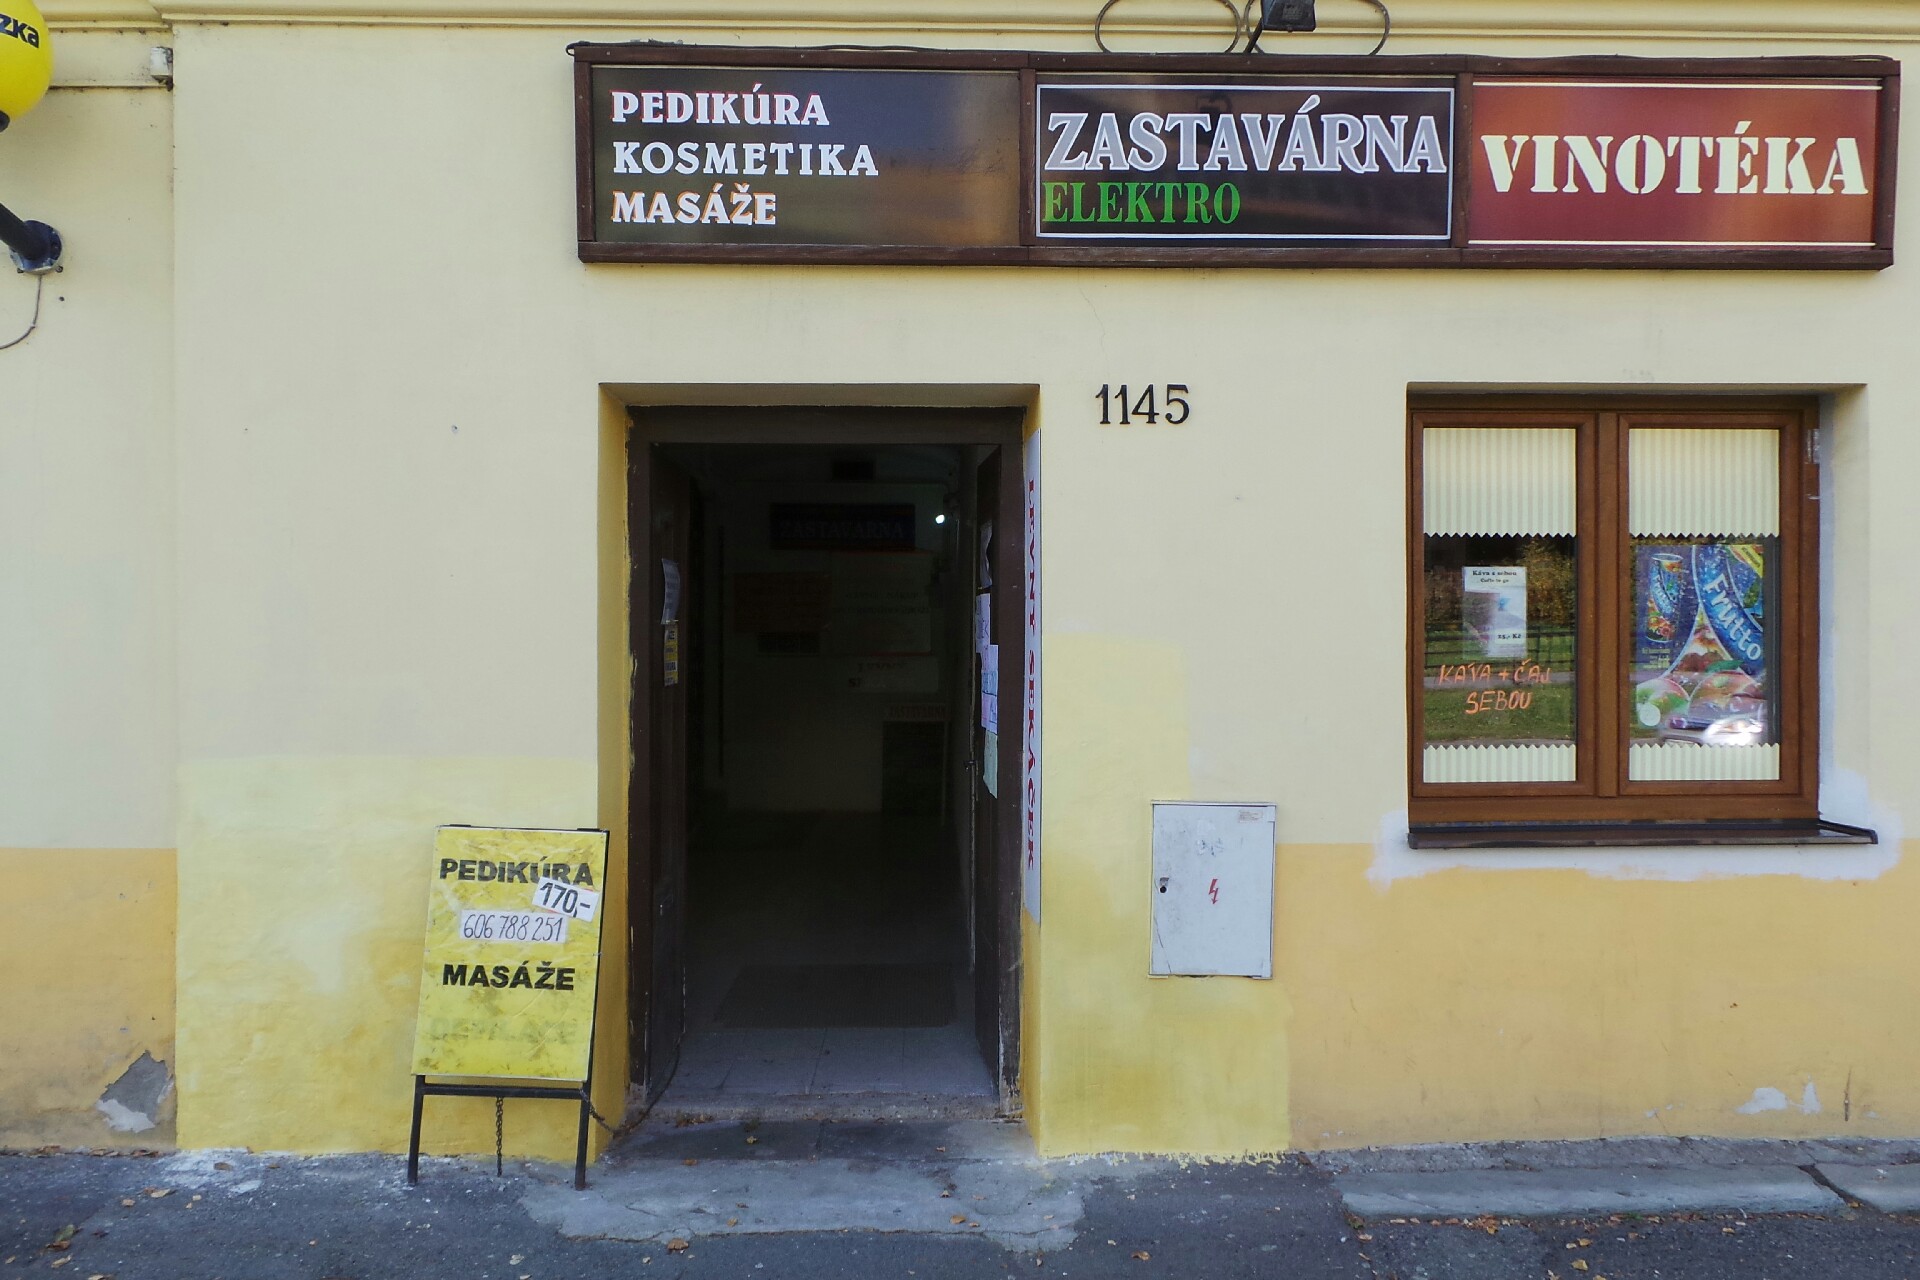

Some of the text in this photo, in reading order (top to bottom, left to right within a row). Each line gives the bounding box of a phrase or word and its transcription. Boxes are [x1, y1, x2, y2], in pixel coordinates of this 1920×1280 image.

[610, 84, 830, 127] PEDIKÚRA
[1044, 94, 1447, 174] ZASTAVÁRNA
[612, 141, 879, 177] KOSMETIKA
[1480, 120, 1869, 195] VINOTÉKA
[611, 182, 778, 226] MASÁŽE
[1042, 181, 1241, 225] ELEKTRO
[1095, 383, 1190, 425] 1145
[1702, 572, 1762, 661] Frutto
[1465, 690, 1534, 715] SEBOU
[439, 856, 594, 886] PEDIKÚRA
[463, 913, 564, 942] 606 788 251
[442, 960, 576, 991] MASÁŽE
